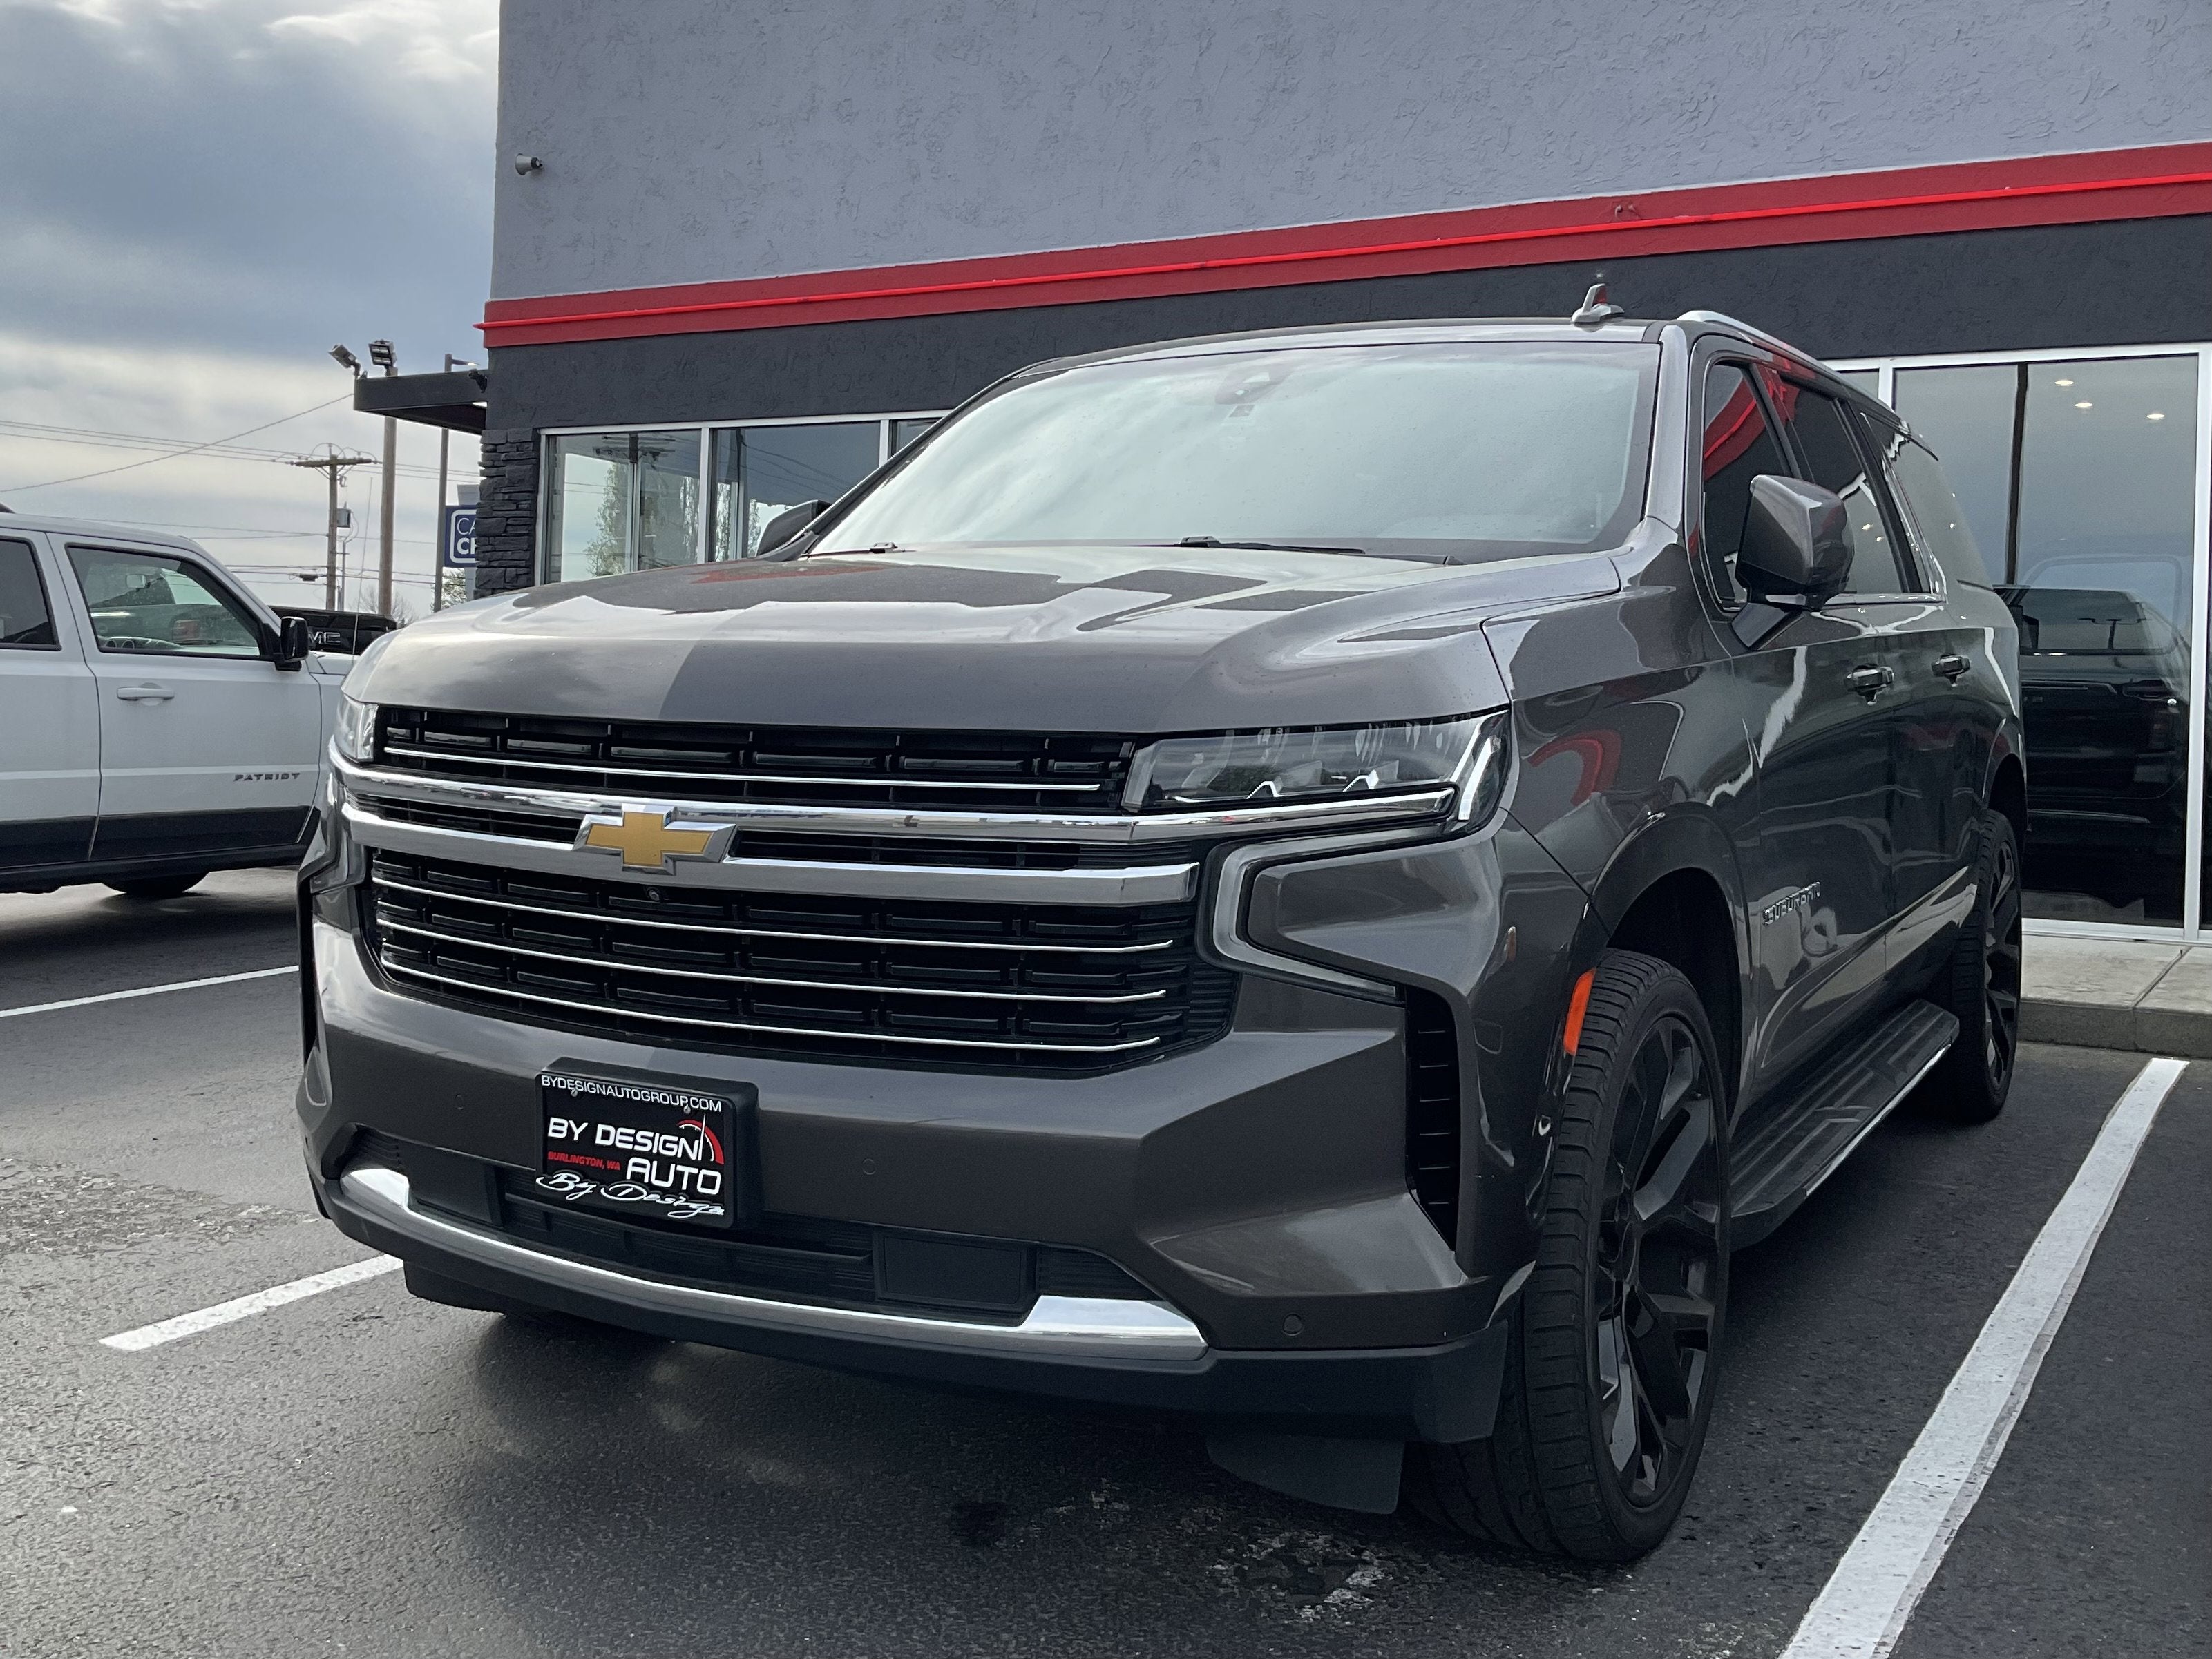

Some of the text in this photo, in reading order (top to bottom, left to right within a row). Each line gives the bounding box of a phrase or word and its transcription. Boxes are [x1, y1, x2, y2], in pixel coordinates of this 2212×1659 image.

[234, 772, 300, 781] PATRIOT
[1762, 881, 1820, 925] SUBURBAN
[548, 1117, 699, 1160] BY DESIGN
[548, 1151, 620, 1171] BURLINGTON, WA
[626, 1157, 722, 1195] AUTO
[535, 1173, 725, 1218] By Design
